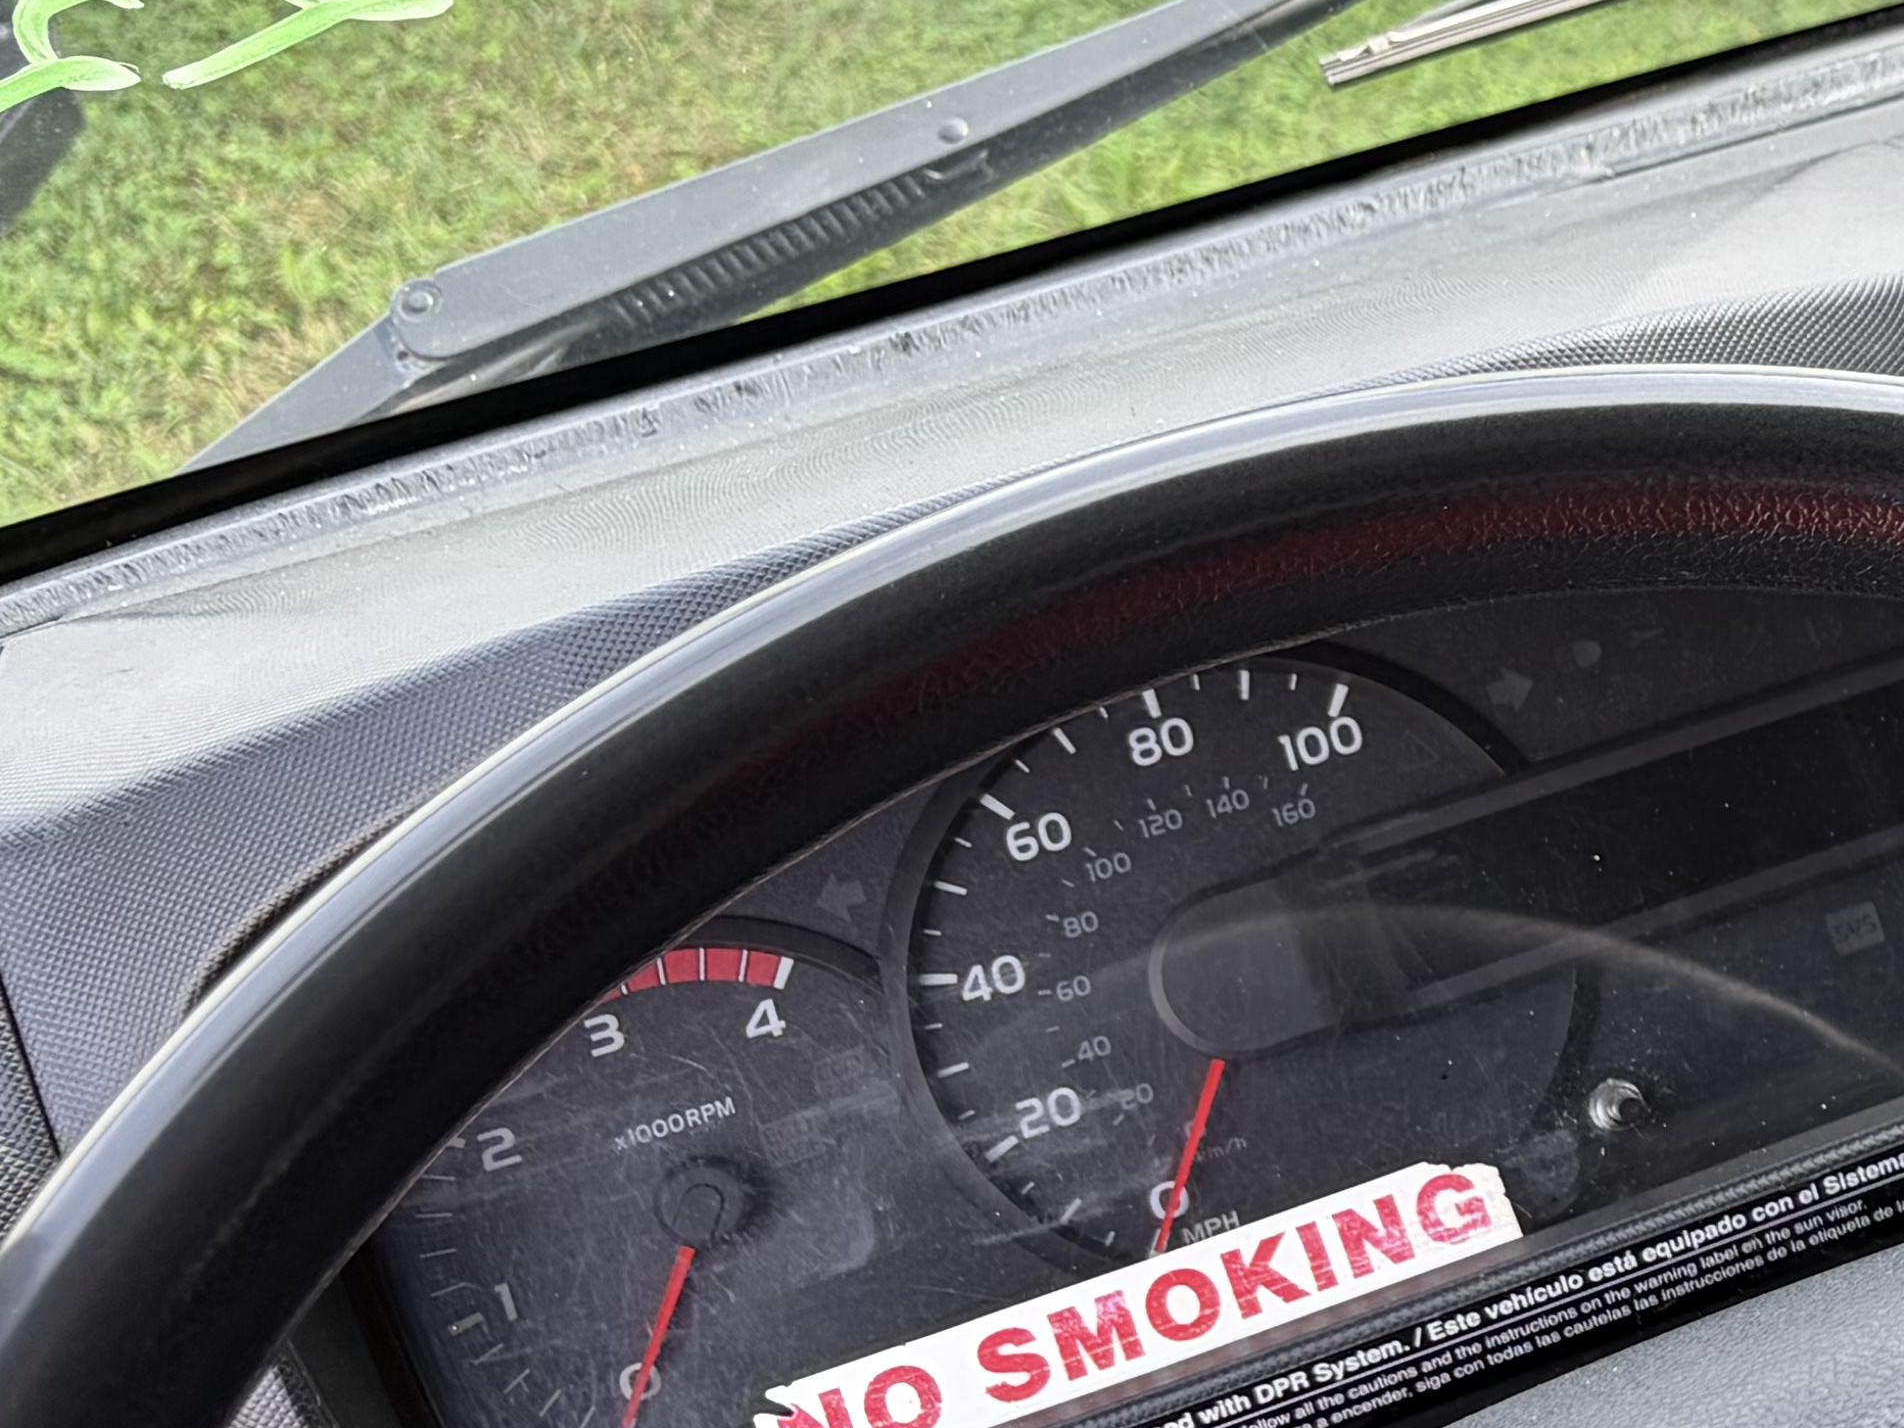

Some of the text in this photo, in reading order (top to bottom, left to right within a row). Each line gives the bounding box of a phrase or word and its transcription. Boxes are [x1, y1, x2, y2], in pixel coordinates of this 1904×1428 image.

[1127, 718, 1363, 771] 80 100
[1007, 788, 1317, 861] 60 120 140 160
[1084, 851, 1133, 883] 100
[1063, 910, 1099, 938] 80
[961, 954, 1091, 1002] 40 60
[584, 999, 787, 1057] 3 4
[1076, 1035, 1112, 1063] 40
[1016, 1083, 1154, 1139] 20 20
[477, 1128, 523, 1173] 2
[1180, 1210, 1241, 1244] MPH
[494, 1281, 519, 1322] 1
[977, 1172, 1493, 1404] SMOKING
[1198, 1395, 1251, 1424] with
[1254, 1372, 1309, 1404] DPR
[1313, 1341, 1412, 1382] System.
[1427, 1312, 1480, 1341] Este
[1588, 1251, 1637, 1281] está
[1642, 1214, 1751, 1262] equipado
[1752, 1197, 1794, 1221] con
[1799, 1183, 1819, 1204] el
[1295, 1402, 1314, 1419] all
[1317, 1394, 1344, 1410] the
[1348, 1367, 1418, 1399] cautions
[1422, 1351, 1452, 1372] and
[1455, 1343, 1482, 1359] the
[1486, 1308, 1577, 1348] instructions
[1581, 1298, 1602, 1313] on
[1604, 1288, 1630, 1304] the
[1634, 1263, 1697, 1293] warning
[1700, 1245, 1738, 1268] label
[1765, 1228, 1790, 1244] the
[1794, 1216, 1823, 1234] sun
[1317, 1418, 1328, 1428] a
[1416, 1373, 1451, 1392] siga
[1454, 1360, 1484, 1378] con
[1487, 1342, 1533, 1365] todas
[1535, 1332, 1561, 1347] las
[1564, 1306, 1631, 1337] cautelas
[1634, 1295, 1658, 1310] las
[1662, 1256, 1764, 1300] instrucciones
[1767, 1247, 1787, 1261] de
[1791, 1240, 1806, 1252] la
[1809, 1216, 1870, 1245] etiqueta
[1874, 1207, 1893, 1221] de
